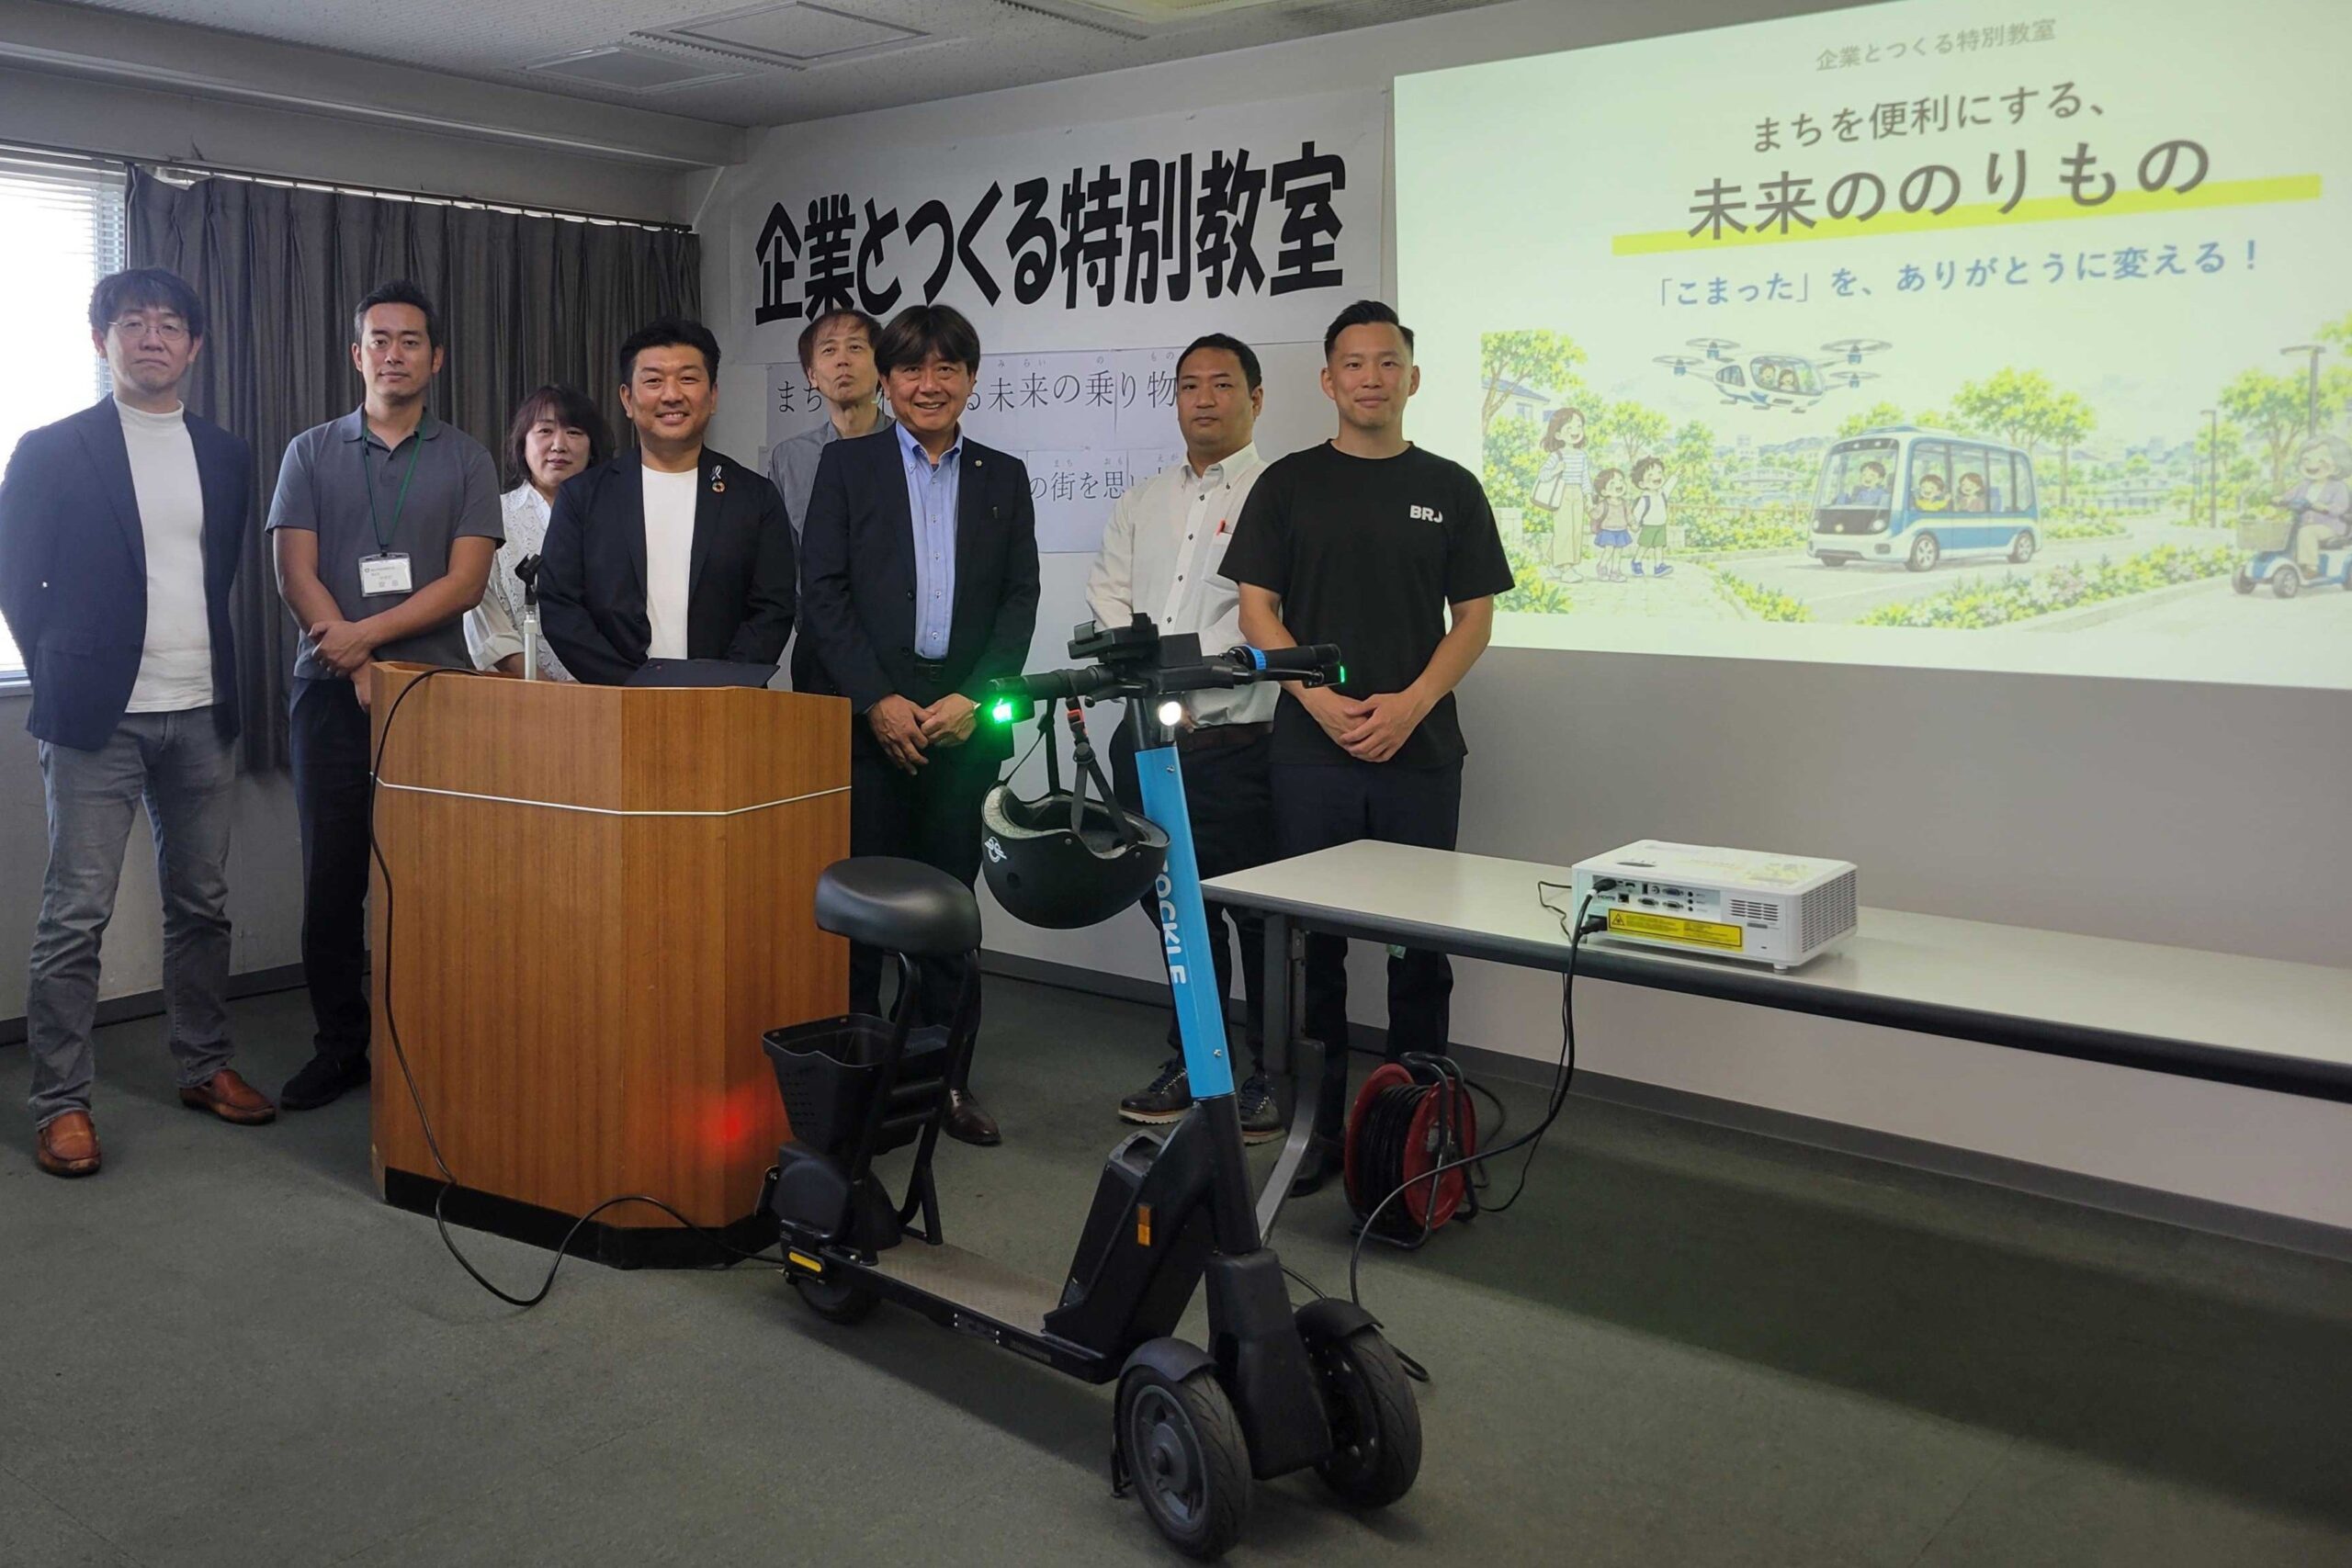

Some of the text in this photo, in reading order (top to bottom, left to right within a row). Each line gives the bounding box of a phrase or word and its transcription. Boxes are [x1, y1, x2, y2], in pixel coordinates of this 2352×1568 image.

[1815, 18, 2056, 72] 企業とつくる特別教室
[1754, 80, 2105, 153] まちを便利にする、
[1688, 138, 2210, 242] 未来ののりもの
[755, 141, 1346, 327] 企業とつくる特別教室
[1409, 504, 1443, 524] BRJ
